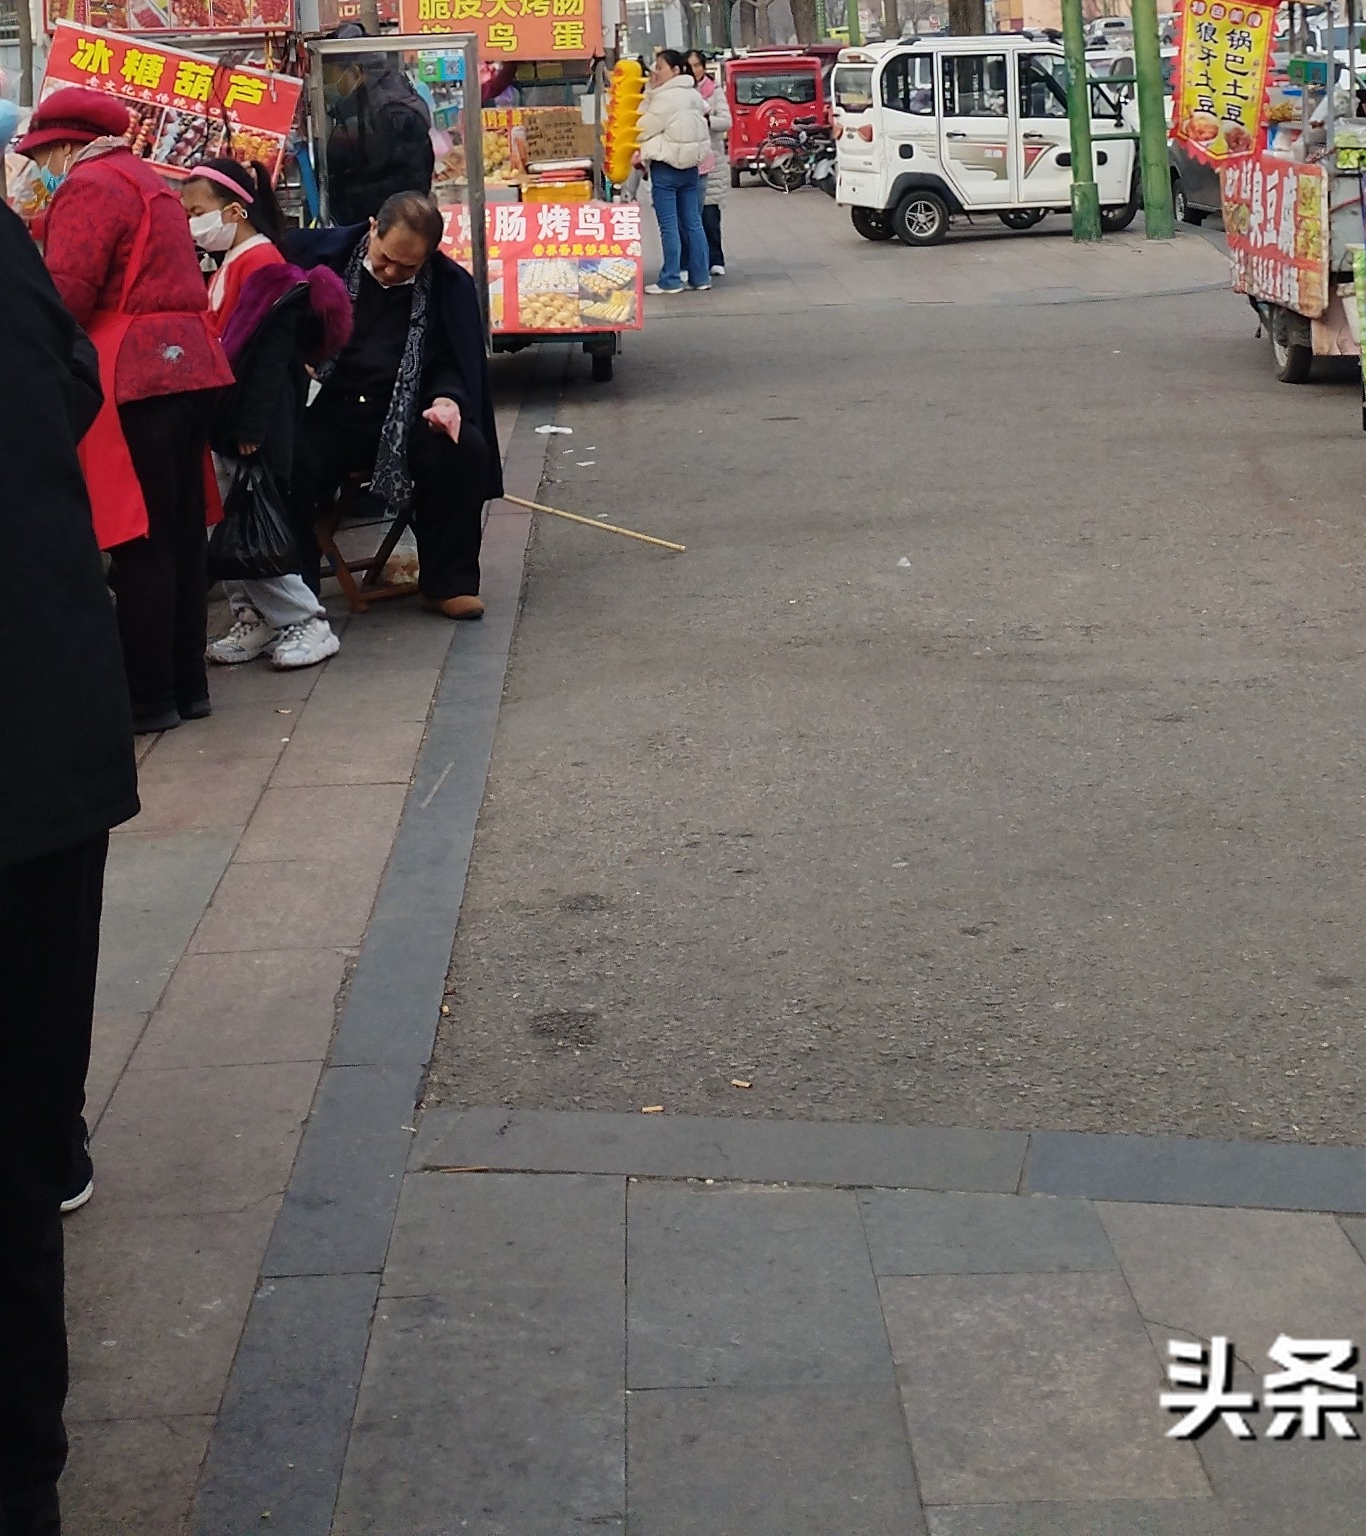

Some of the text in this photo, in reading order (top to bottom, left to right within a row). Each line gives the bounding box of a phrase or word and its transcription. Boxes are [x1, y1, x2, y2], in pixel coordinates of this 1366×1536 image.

[69, 37, 269, 109] 冰糖葫芦
[1193, 21, 1219, 118] 狼牙土豆
[1221, 28, 1253, 127] 锅巴土豆
[537, 203, 642, 243] 烤鸟蛋
[1249, 161, 1298, 259] 臭豆腐
